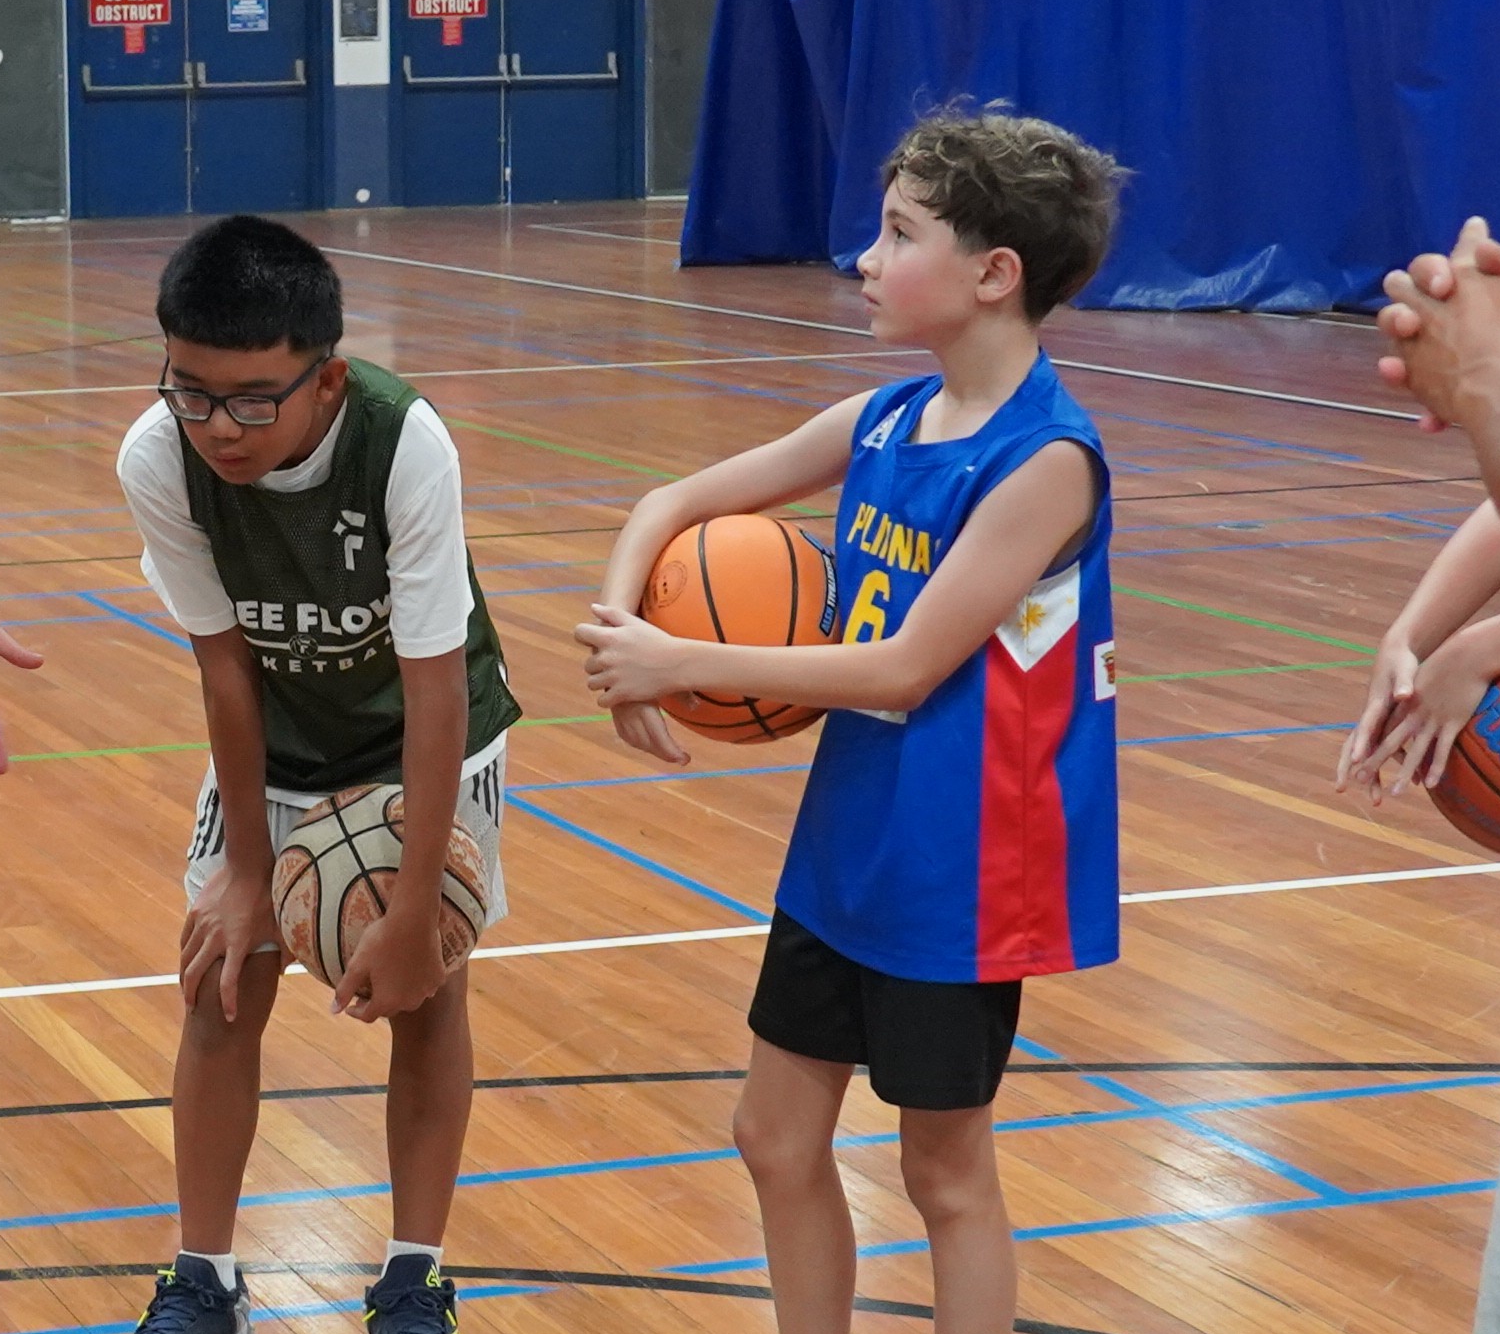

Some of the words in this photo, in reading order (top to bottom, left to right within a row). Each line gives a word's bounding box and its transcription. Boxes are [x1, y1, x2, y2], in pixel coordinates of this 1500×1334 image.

[95, 3, 164, 21] OBSTRUCT
[236, 600, 285, 631] EE
[842, 570, 890, 645] 6
